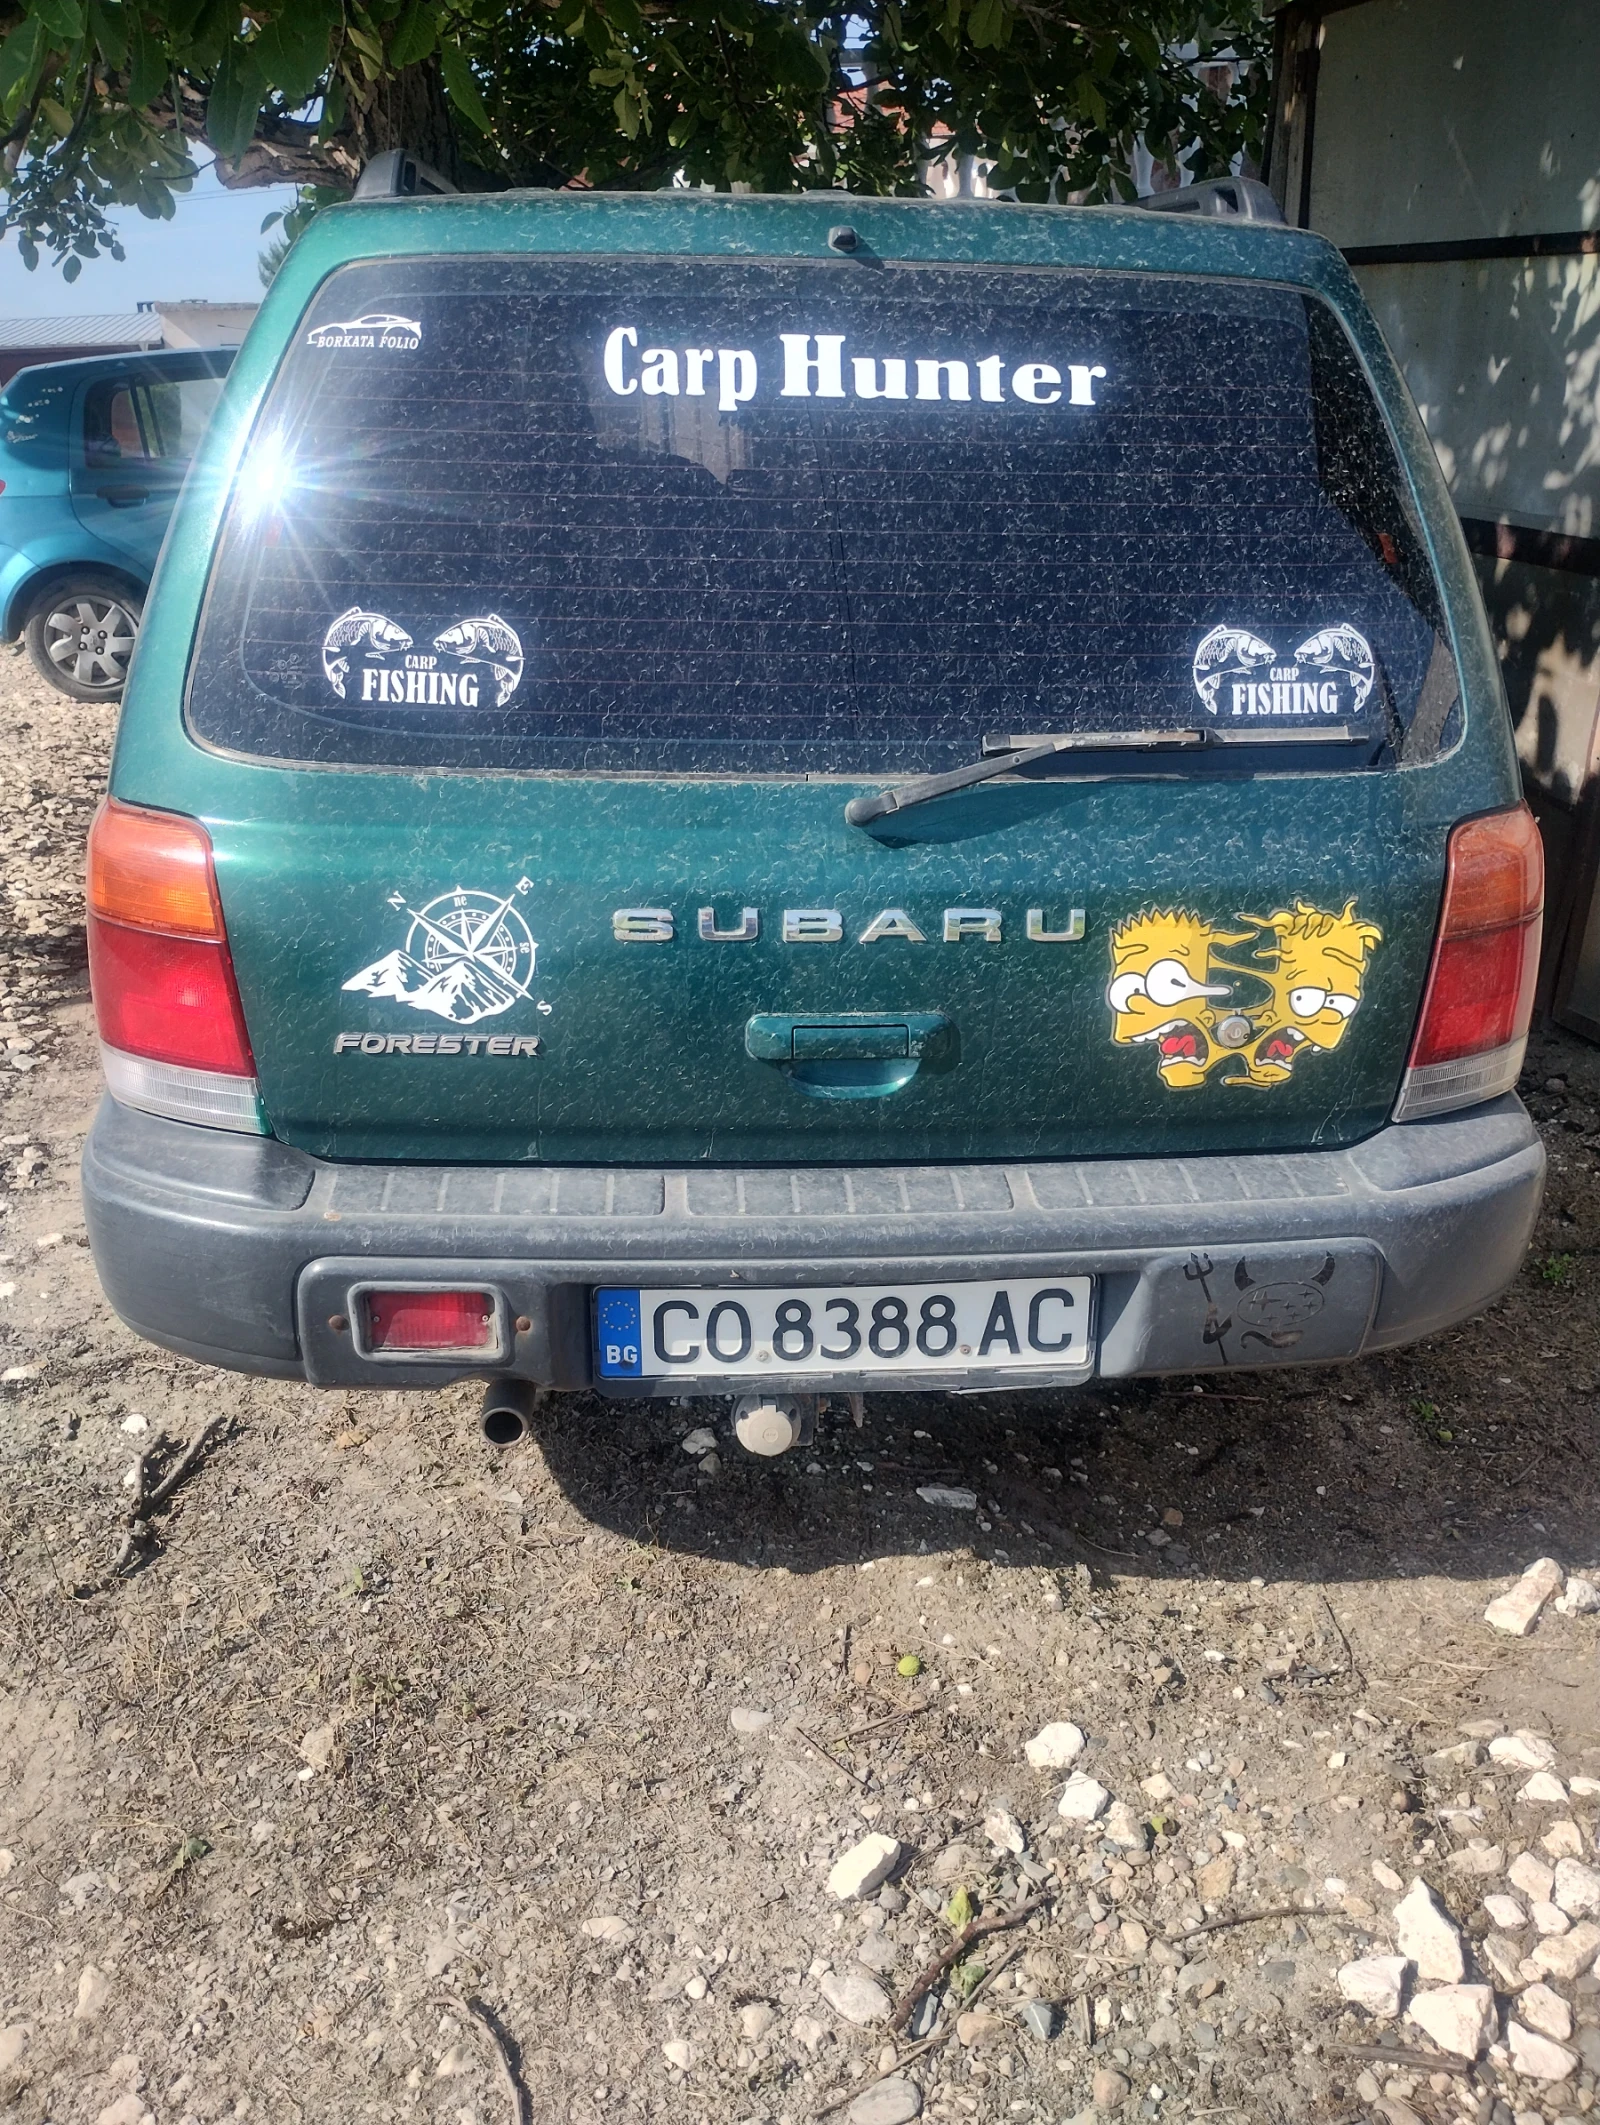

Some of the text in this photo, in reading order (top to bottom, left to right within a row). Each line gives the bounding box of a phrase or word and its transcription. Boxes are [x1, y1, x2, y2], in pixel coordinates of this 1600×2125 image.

[316, 335, 419, 350] BORKATA FOLIO
[603, 326, 1107, 411] Carp Hunter
[405, 654, 438, 670] CARP
[1269, 667, 1300, 681] CARP
[361, 668, 480, 707] FISHING
[1231, 681, 1339, 715] FISHING
[515, 875, 534, 895] E
[387, 890, 406, 911] N
[612, 907, 1087, 942] SUBARU
[536, 1000, 553, 1016] S
[334, 1032, 541, 1056] FORESTER
[653, 1287, 1075, 1364] CO 8388 AC
[606, 1345, 638, 1364] BG
